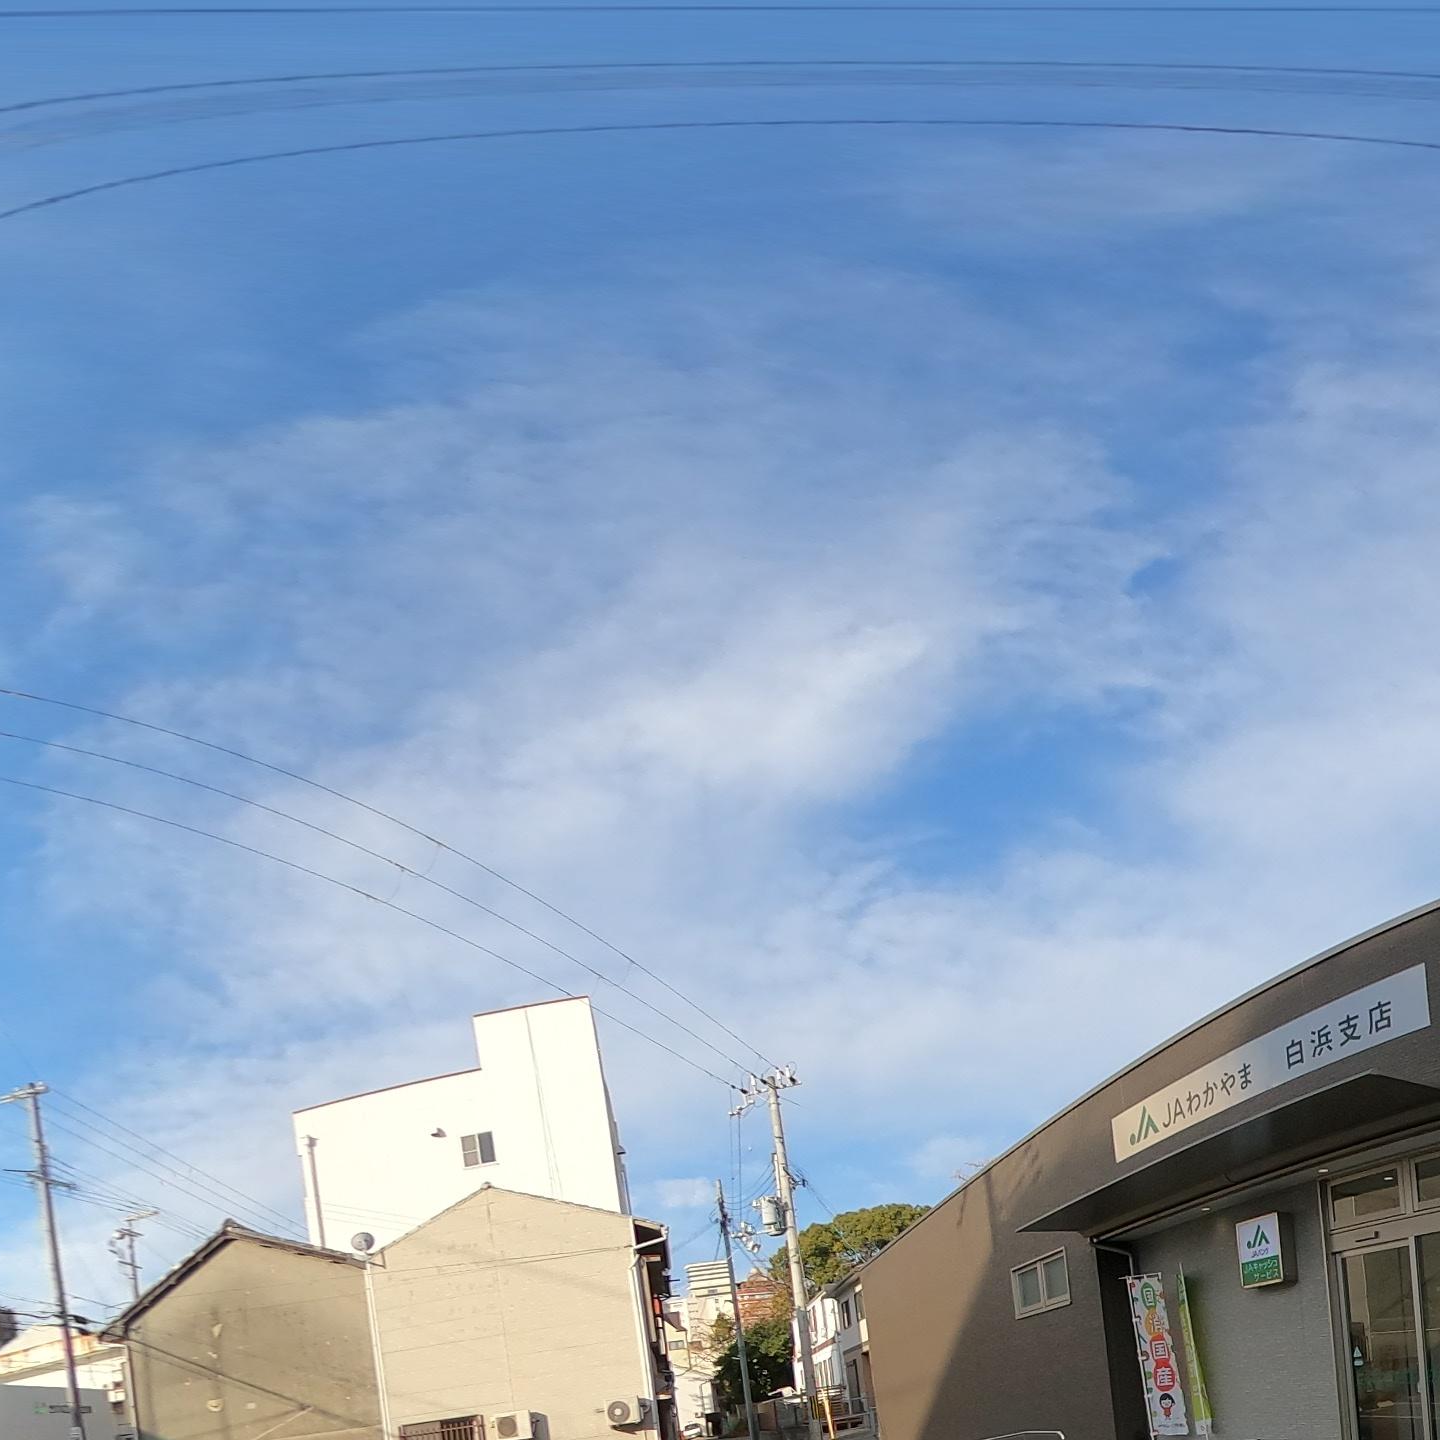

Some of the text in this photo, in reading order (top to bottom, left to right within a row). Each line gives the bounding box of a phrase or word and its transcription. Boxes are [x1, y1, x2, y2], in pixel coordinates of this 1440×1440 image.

[1162, 1063, 1253, 1128] JAわかやま
[1285, 1001, 1392, 1069] 白浜支店
[1243, 1259, 1278, 1274] JAキャッシュ
[1254, 1269, 1279, 1282] サービス
